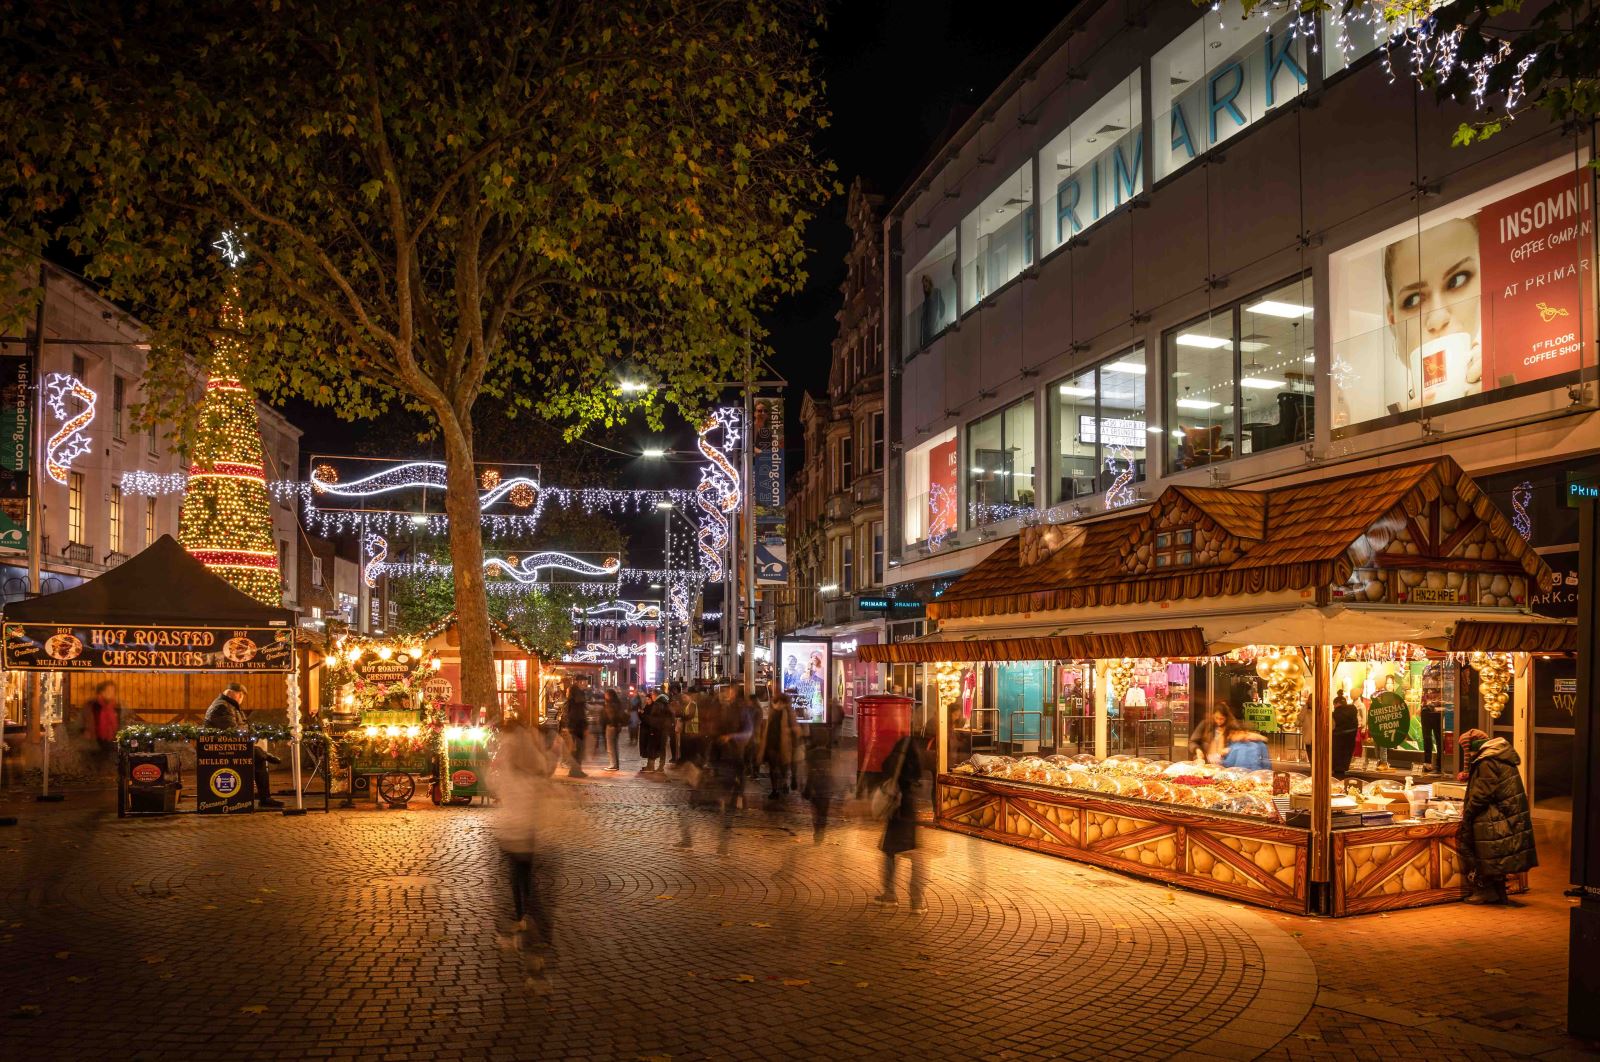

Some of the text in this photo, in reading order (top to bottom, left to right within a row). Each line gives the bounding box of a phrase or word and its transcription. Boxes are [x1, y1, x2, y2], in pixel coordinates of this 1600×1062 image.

[1500, 182, 1589, 244] INSOMNI
[1510, 219, 1592, 263] COFFEE COMPAN
[1504, 258, 1589, 299] AT PRIMAR
[1544, 333, 1575, 349] FLOOR
[1523, 341, 1586, 366] COFFEE SHOP
[12, 363, 27, 472] visit-reading.com
[769, 404, 782, 507] visit-reading.com
[1570, 484, 1598, 497] PRIM
[1437, 590, 1454, 601] HPE
[91, 629, 215, 647] HOT ROASTED
[102, 650, 204, 667] CHESTNUTS
[362, 665, 376, 673] HOT
[366, 673, 405, 681] CHESTNUTS
[425, 686, 452, 694] ONUT
[1370, 702, 1406, 717] CHRISTMAS
[1374, 711, 1403, 723] JUMPERS
[1379, 720, 1400, 731] FROM
[1383, 729, 1397, 742] £7
[203, 743, 248, 751] CHESTNUTS
